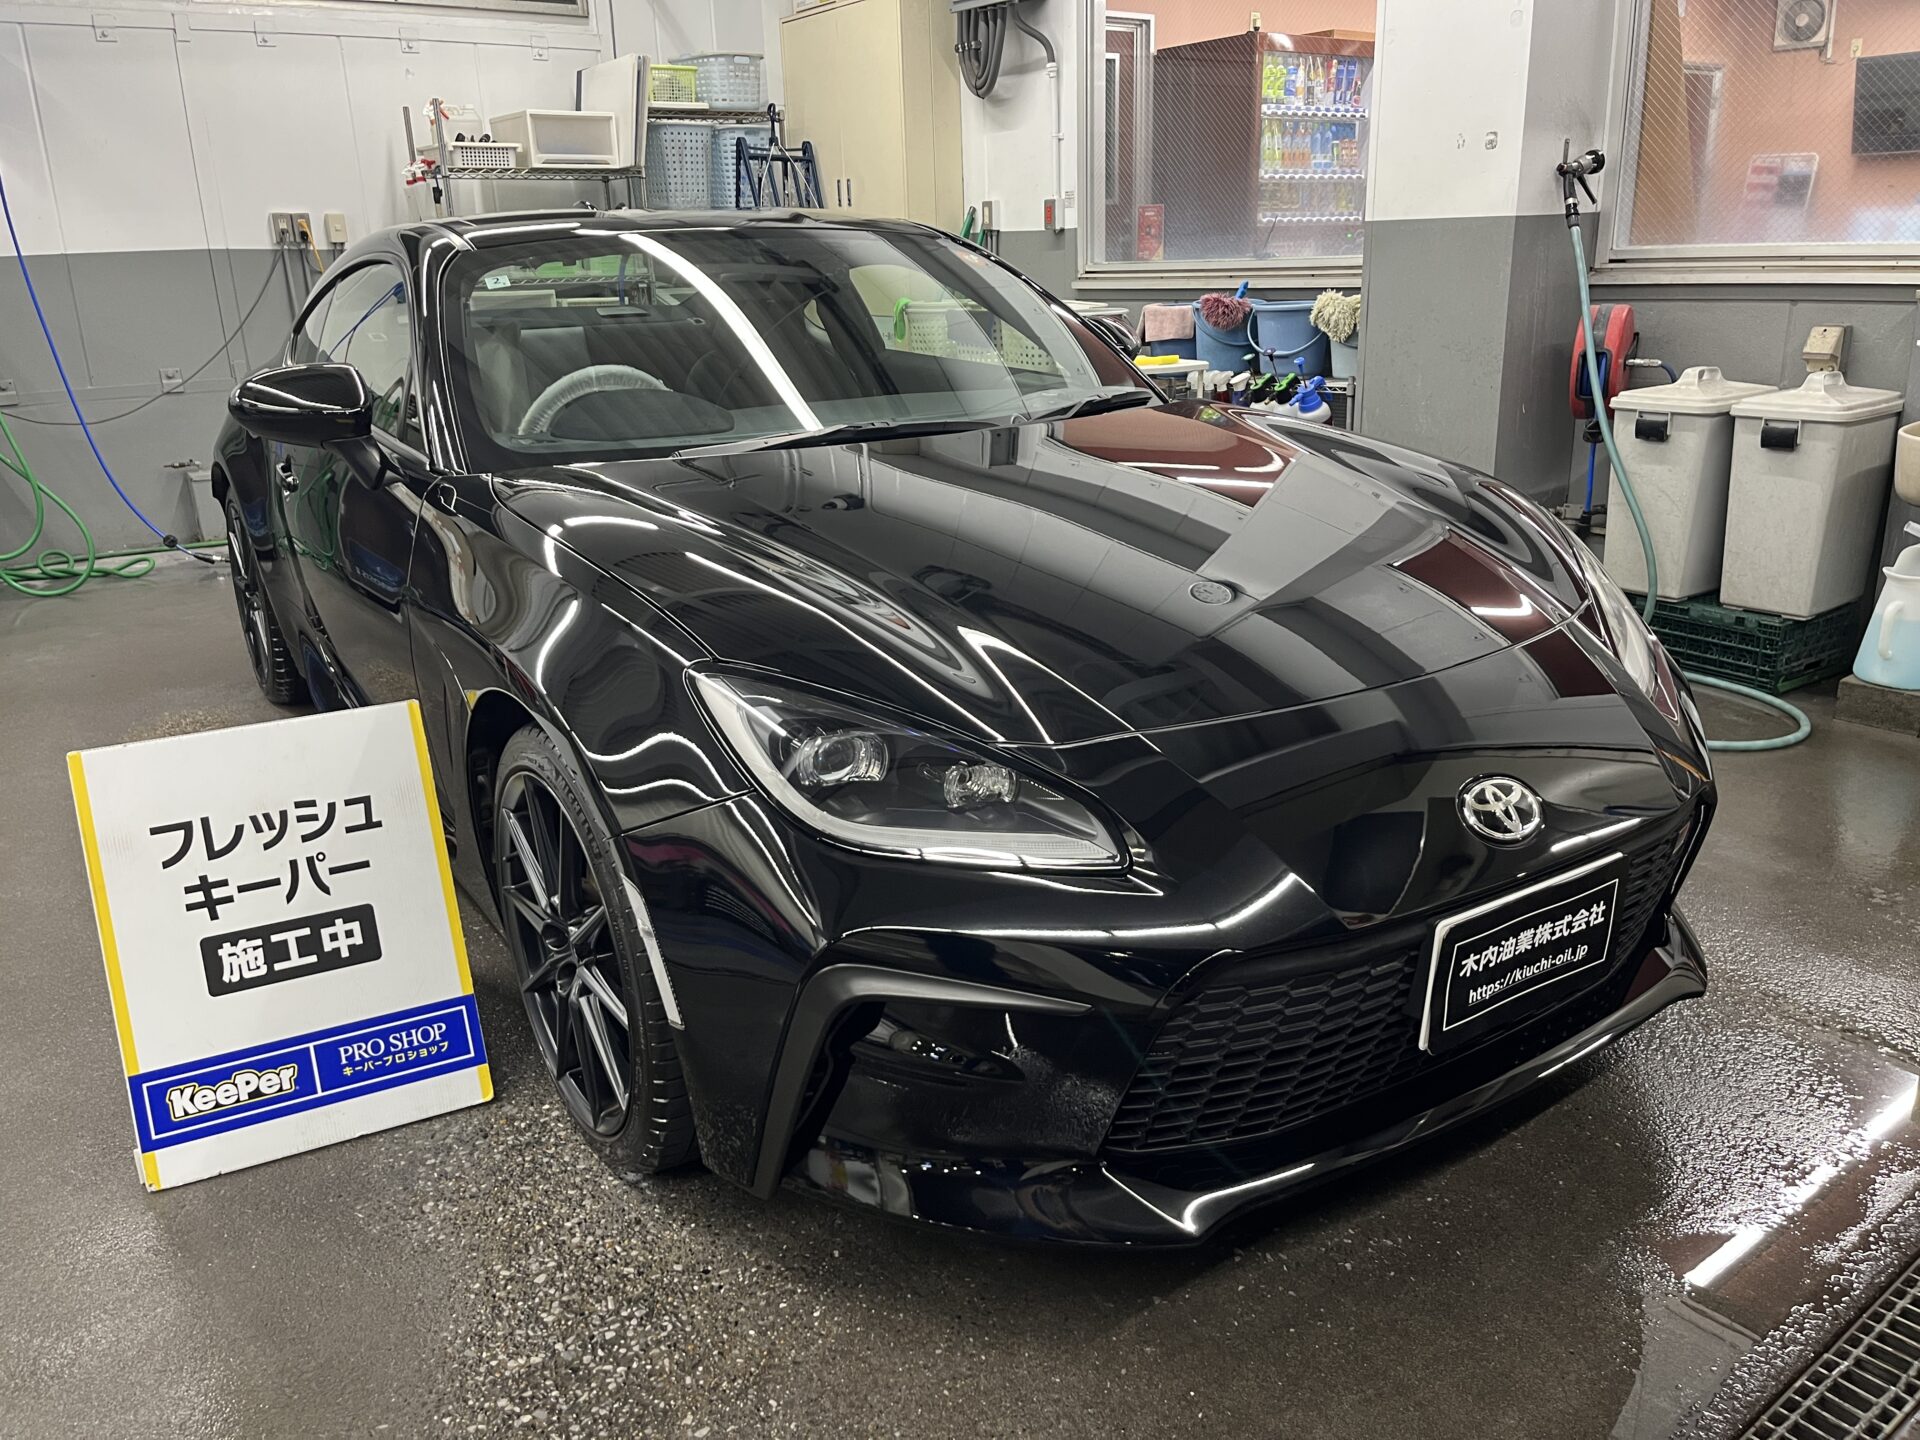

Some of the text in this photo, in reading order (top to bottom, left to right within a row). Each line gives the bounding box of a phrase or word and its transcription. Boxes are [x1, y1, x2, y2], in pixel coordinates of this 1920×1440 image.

[149, 795, 383, 869] フレッシュ
[184, 852, 371, 921] キーパー
[218, 919, 364, 985] 施工中
[1459, 901, 1606, 977] 木内油業株式会社
[1468, 944, 1588, 1006] https://kiuchi-oil.jp
[338, 1022, 446, 1065] PRO SHOP
[343, 1041, 448, 1076] キーパープロショップ
[166, 1063, 298, 1121] KeePer
